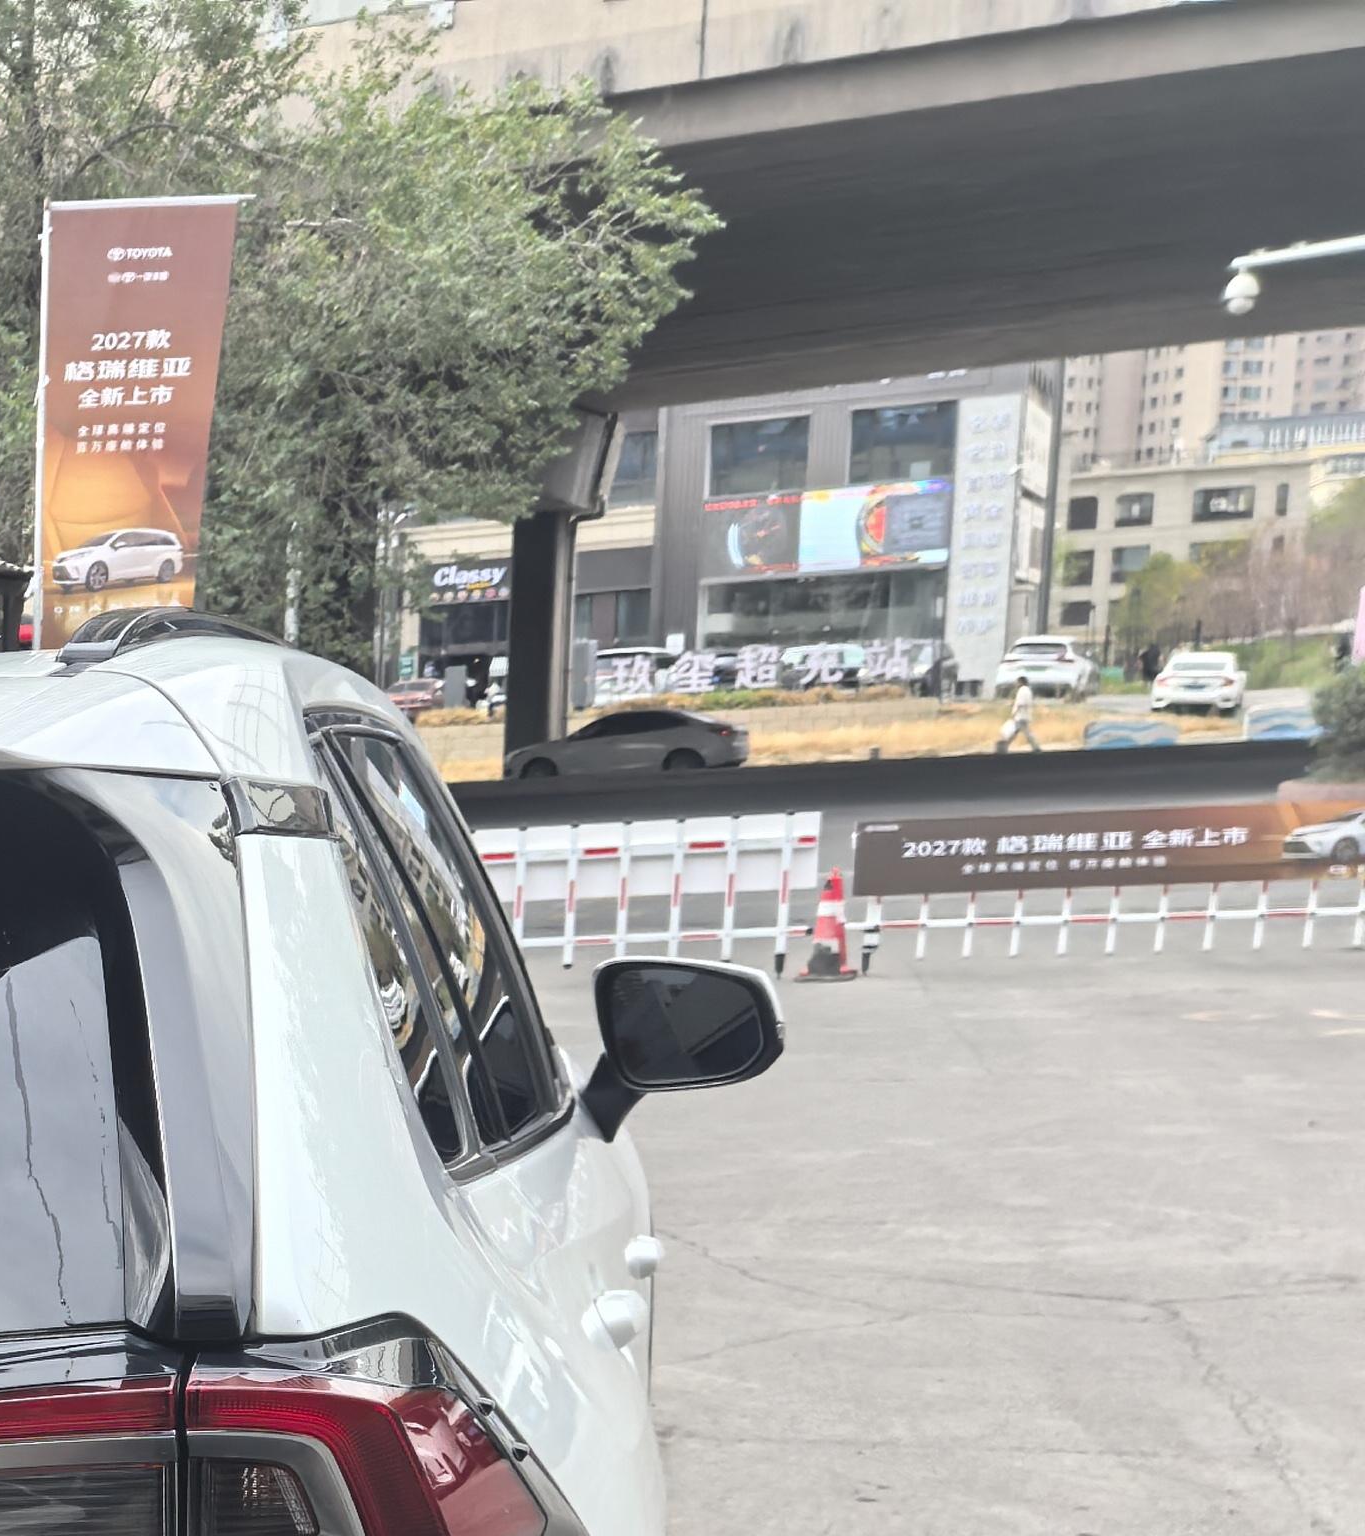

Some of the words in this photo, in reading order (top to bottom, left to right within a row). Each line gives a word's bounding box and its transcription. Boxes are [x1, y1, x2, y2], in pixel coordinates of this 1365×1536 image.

[126, 247, 173, 259] TOYOTA
[91, 329, 172, 351] 2027款
[64, 357, 192, 384] 格瑞维亚
[78, 384, 175, 410] 全新上市
[433, 565, 508, 588] Classy
[901, 837, 987, 858] 2027款
[996, 830, 1133, 854] 格瑞维亚
[1141, 826, 1249, 849] 全新上市
